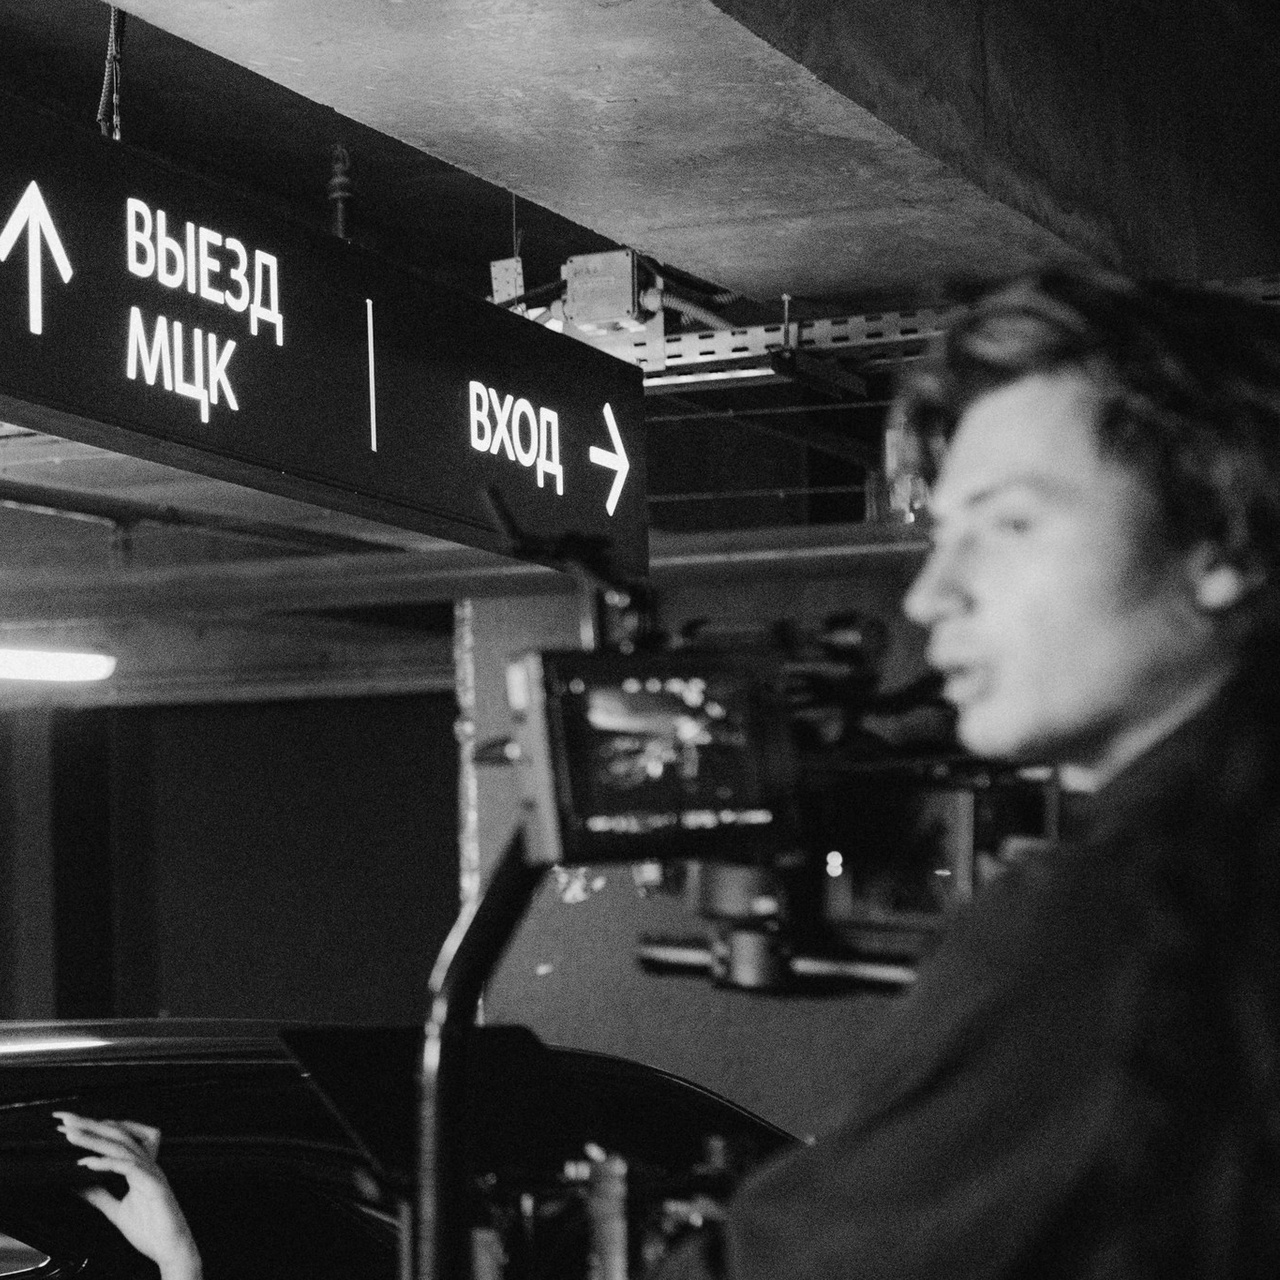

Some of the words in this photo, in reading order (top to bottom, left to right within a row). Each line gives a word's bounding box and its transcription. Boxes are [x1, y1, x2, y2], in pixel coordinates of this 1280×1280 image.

[126, 197, 285, 347] ВЫЕЗД
[126, 306, 240, 424] МЦК
[468, 380, 564, 496] ВХОД
